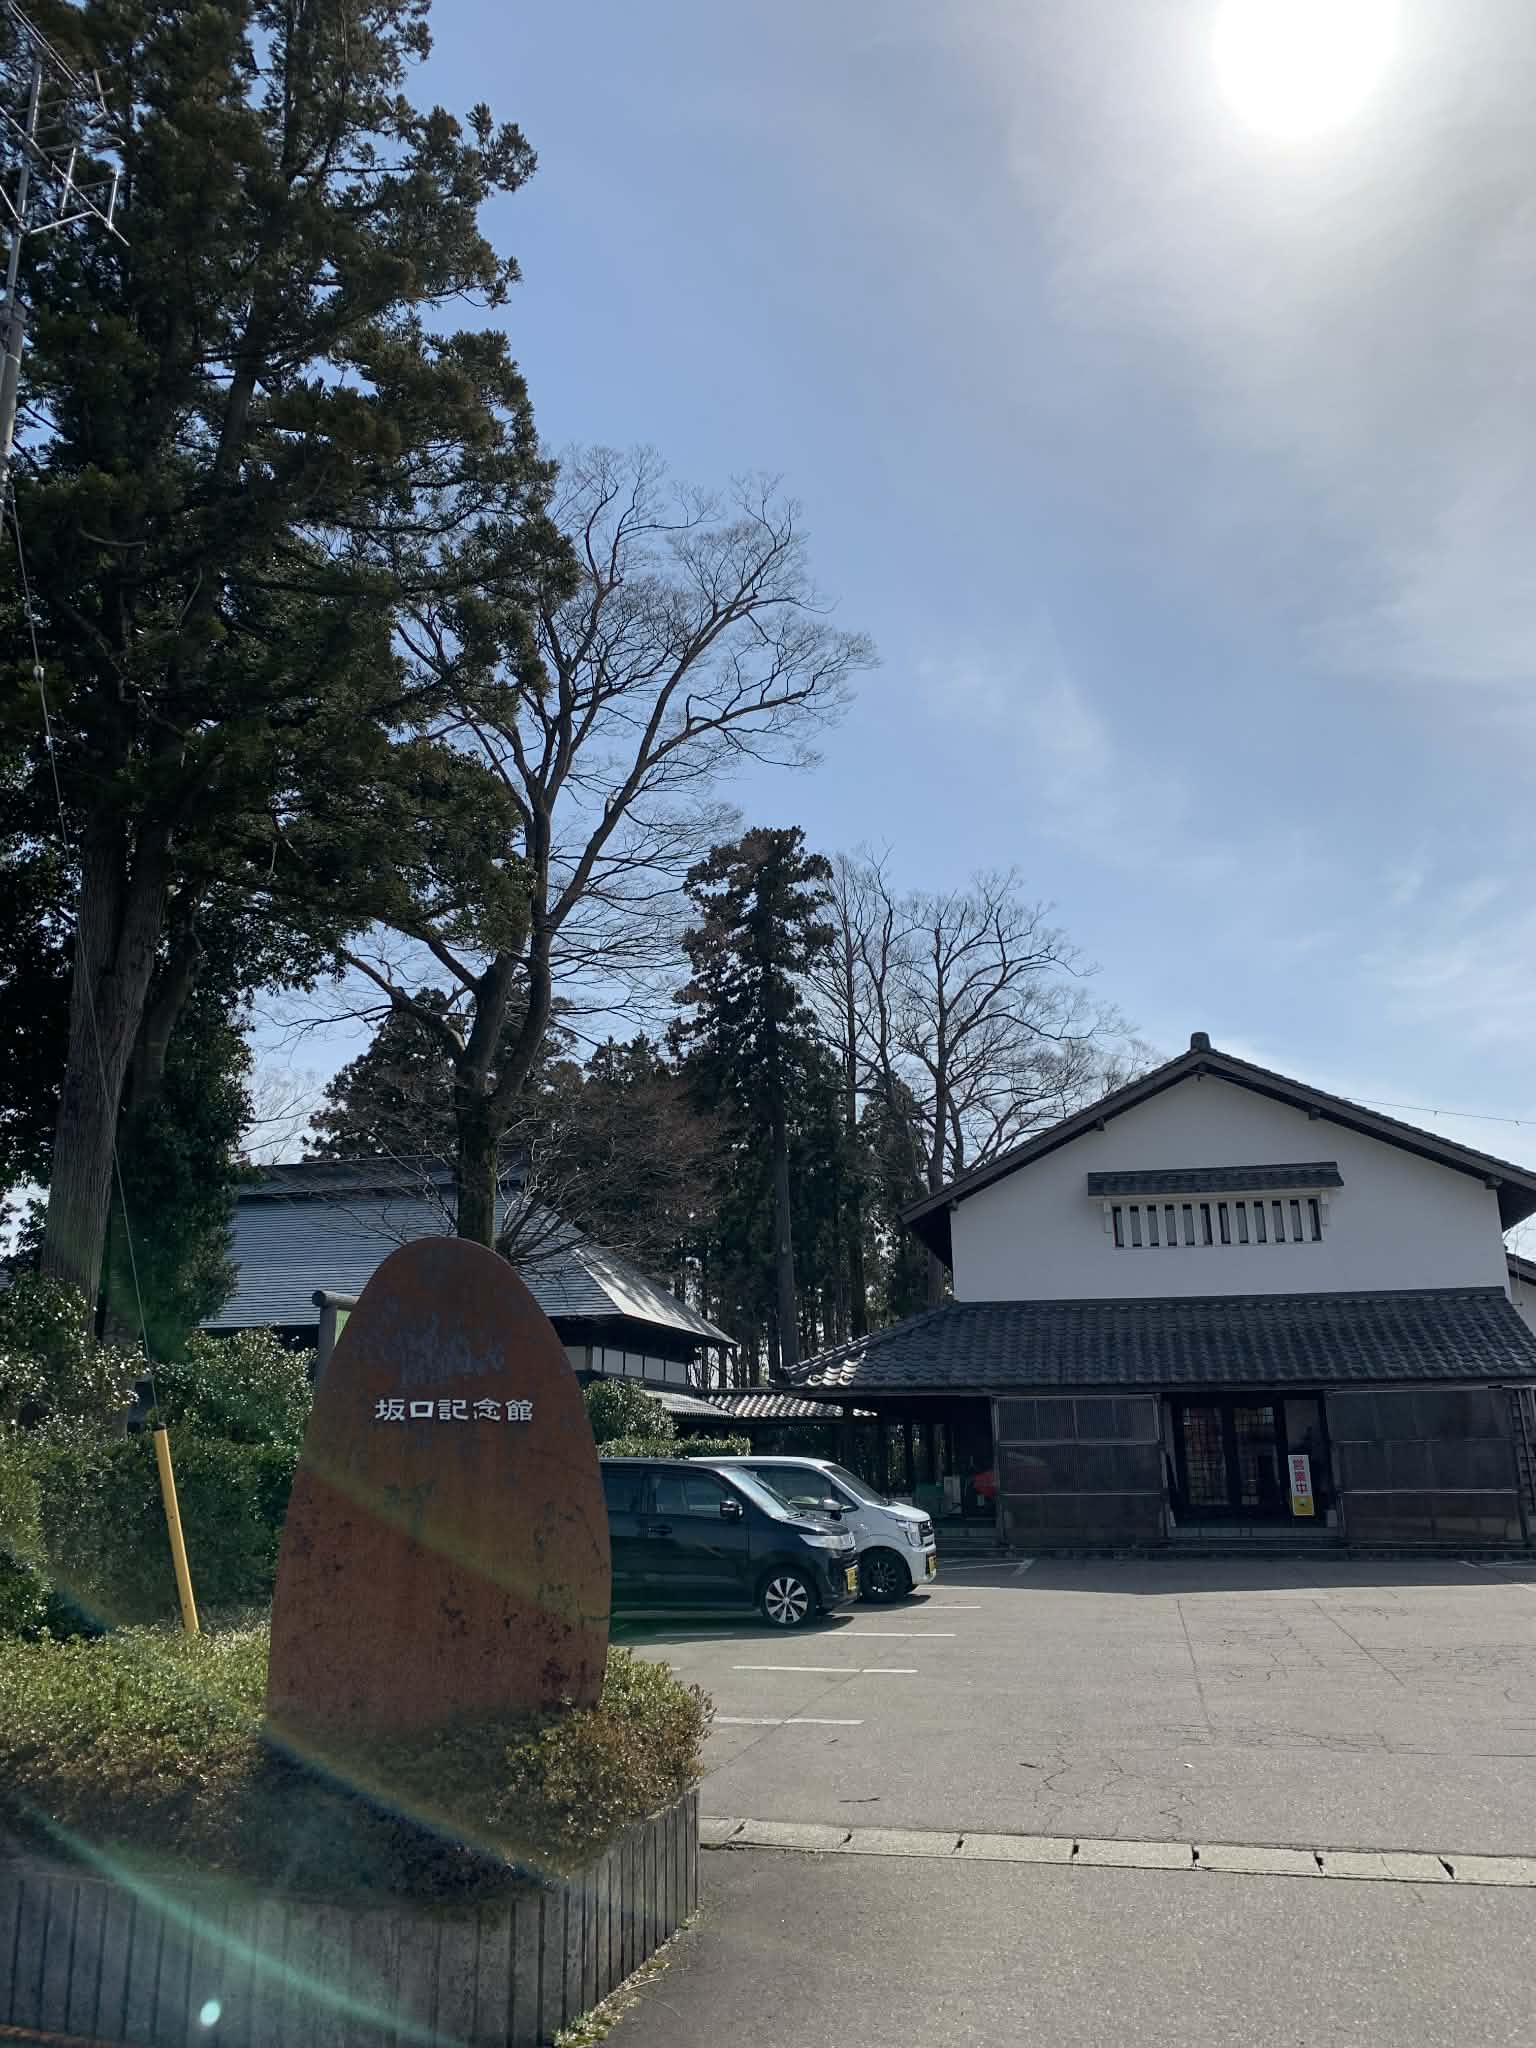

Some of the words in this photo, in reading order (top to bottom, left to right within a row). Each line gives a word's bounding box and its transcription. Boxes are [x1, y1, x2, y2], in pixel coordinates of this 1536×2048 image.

[375, 1398, 533, 1421] 坂口記念館
[1293, 1456, 1307, 1494] 営業中
